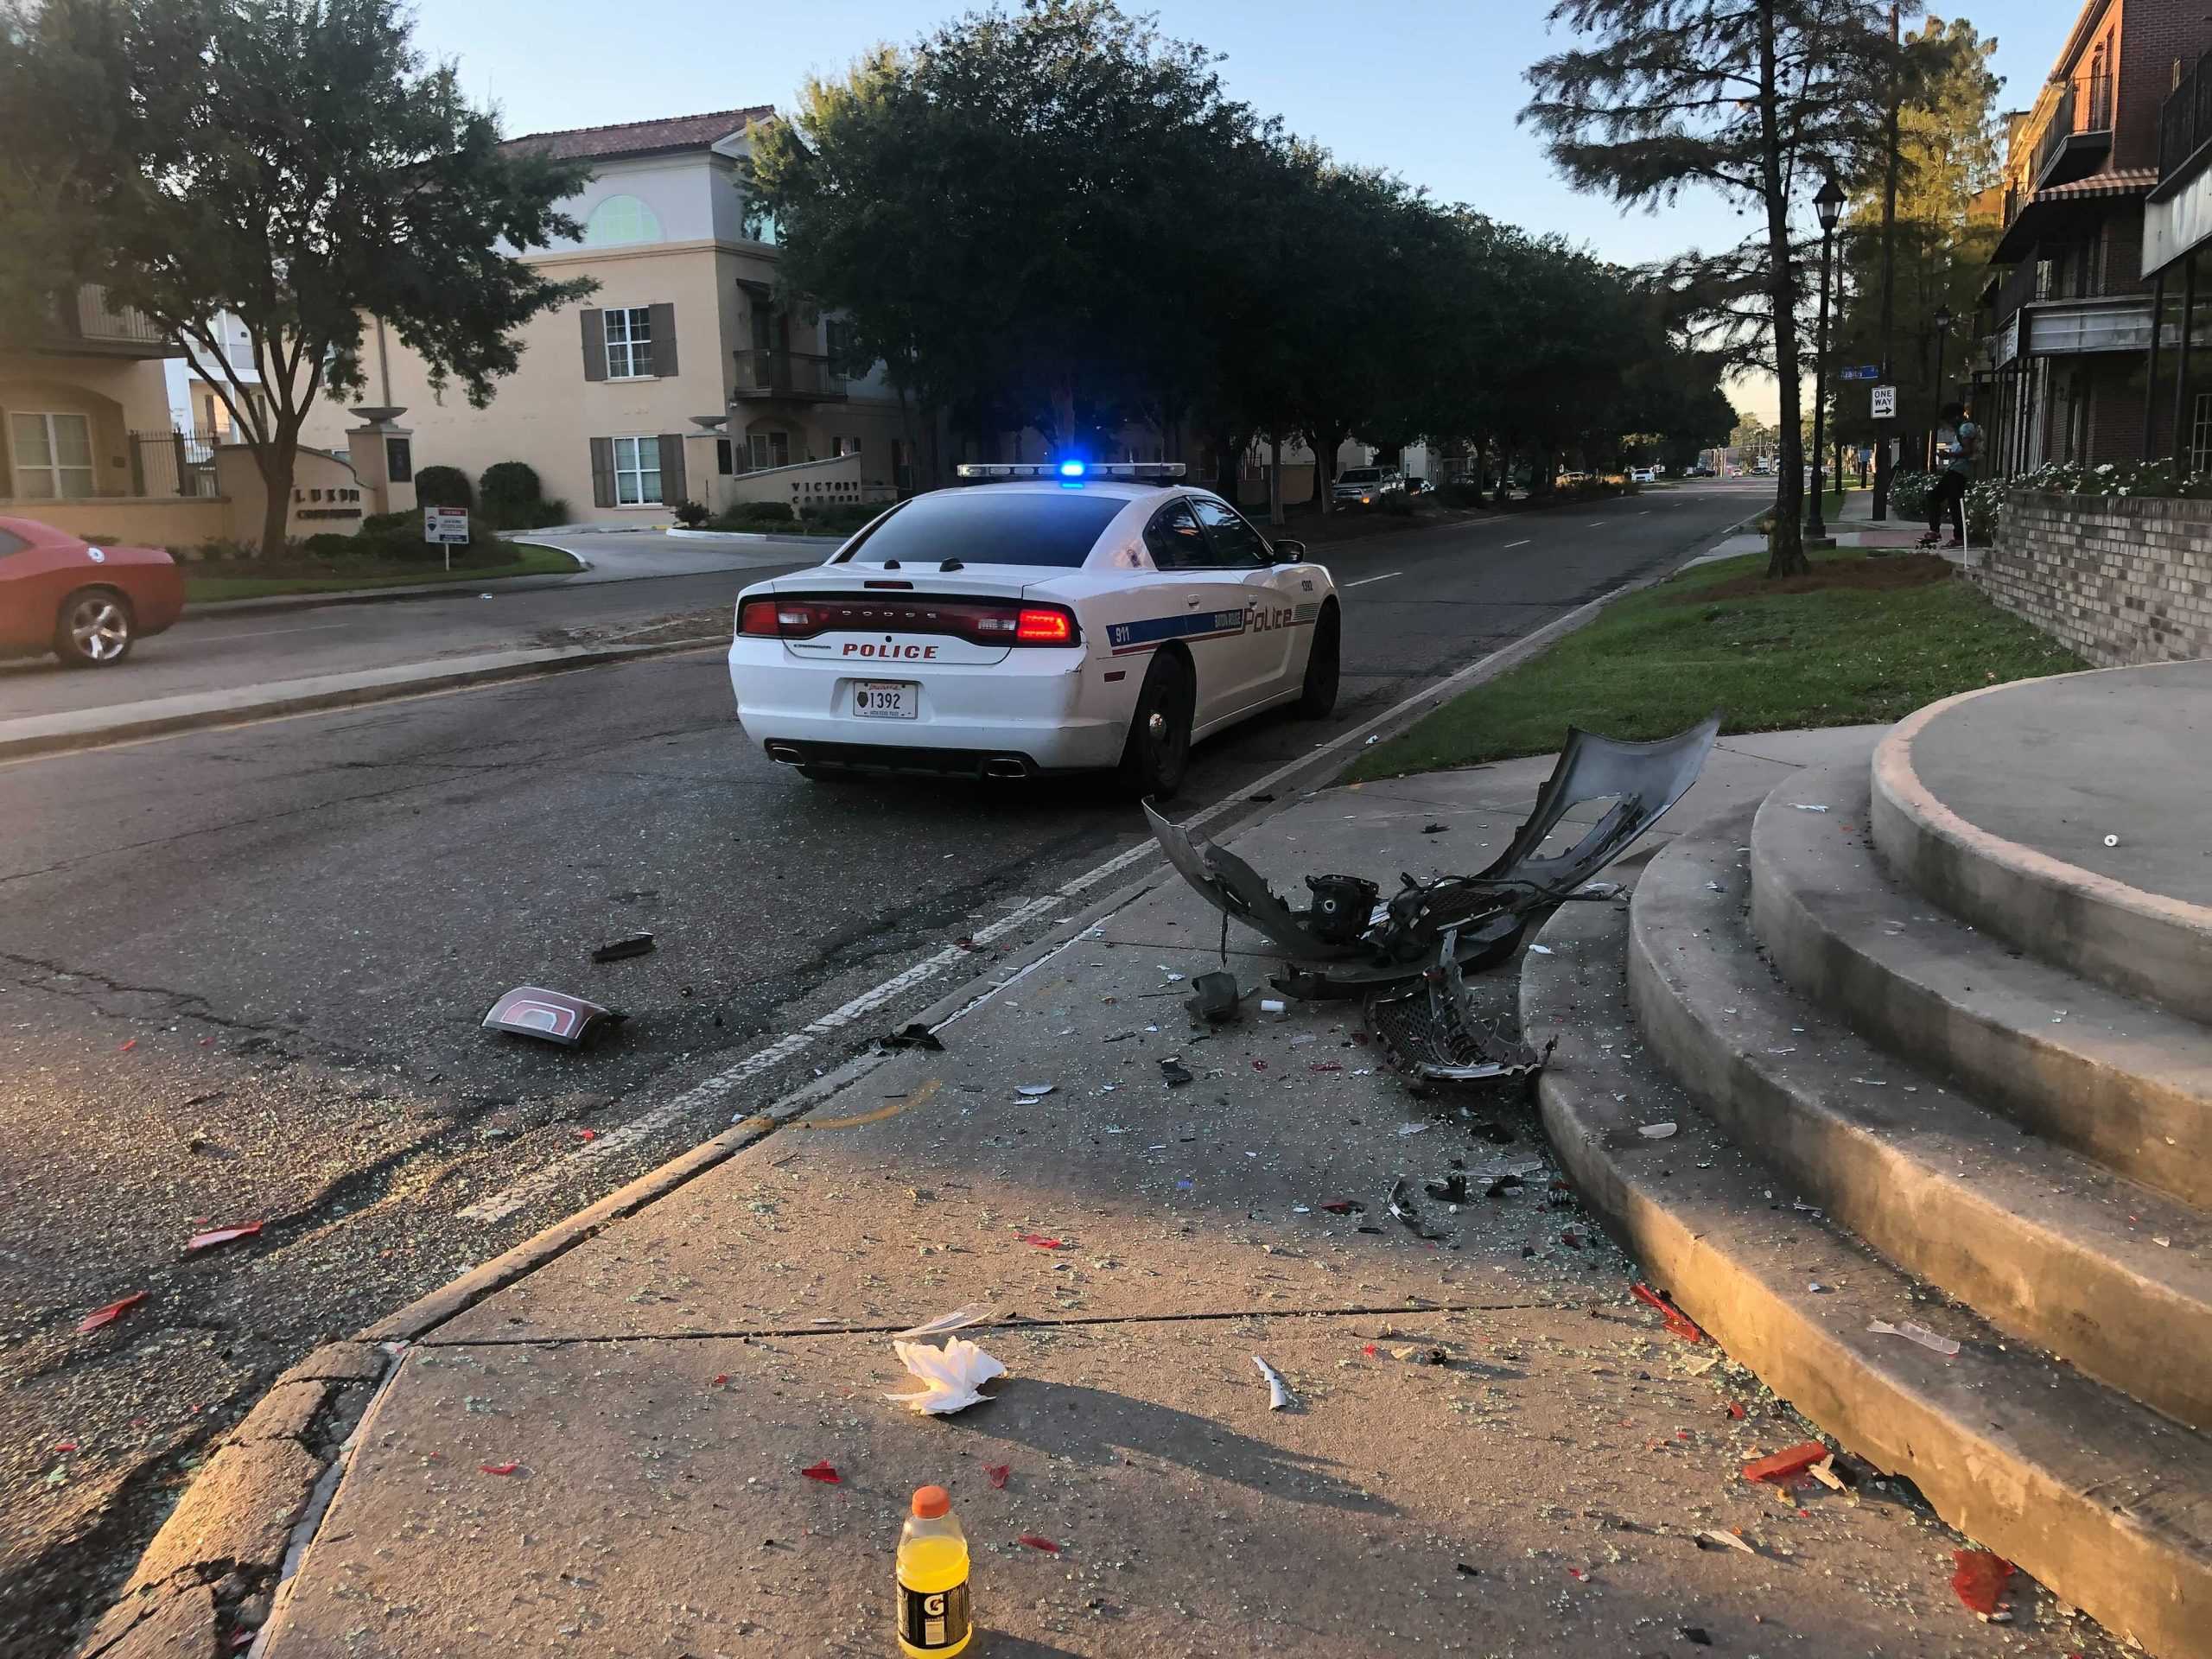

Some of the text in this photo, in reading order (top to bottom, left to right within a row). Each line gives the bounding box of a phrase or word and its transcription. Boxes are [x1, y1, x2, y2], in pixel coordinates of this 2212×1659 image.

[791, 482, 858, 492] VICTORY
[1116, 626, 1130, 643] 911
[842, 643, 939, 658] POLICE
[870, 692, 900, 709] 1392
[924, 1594, 944, 1616] G
